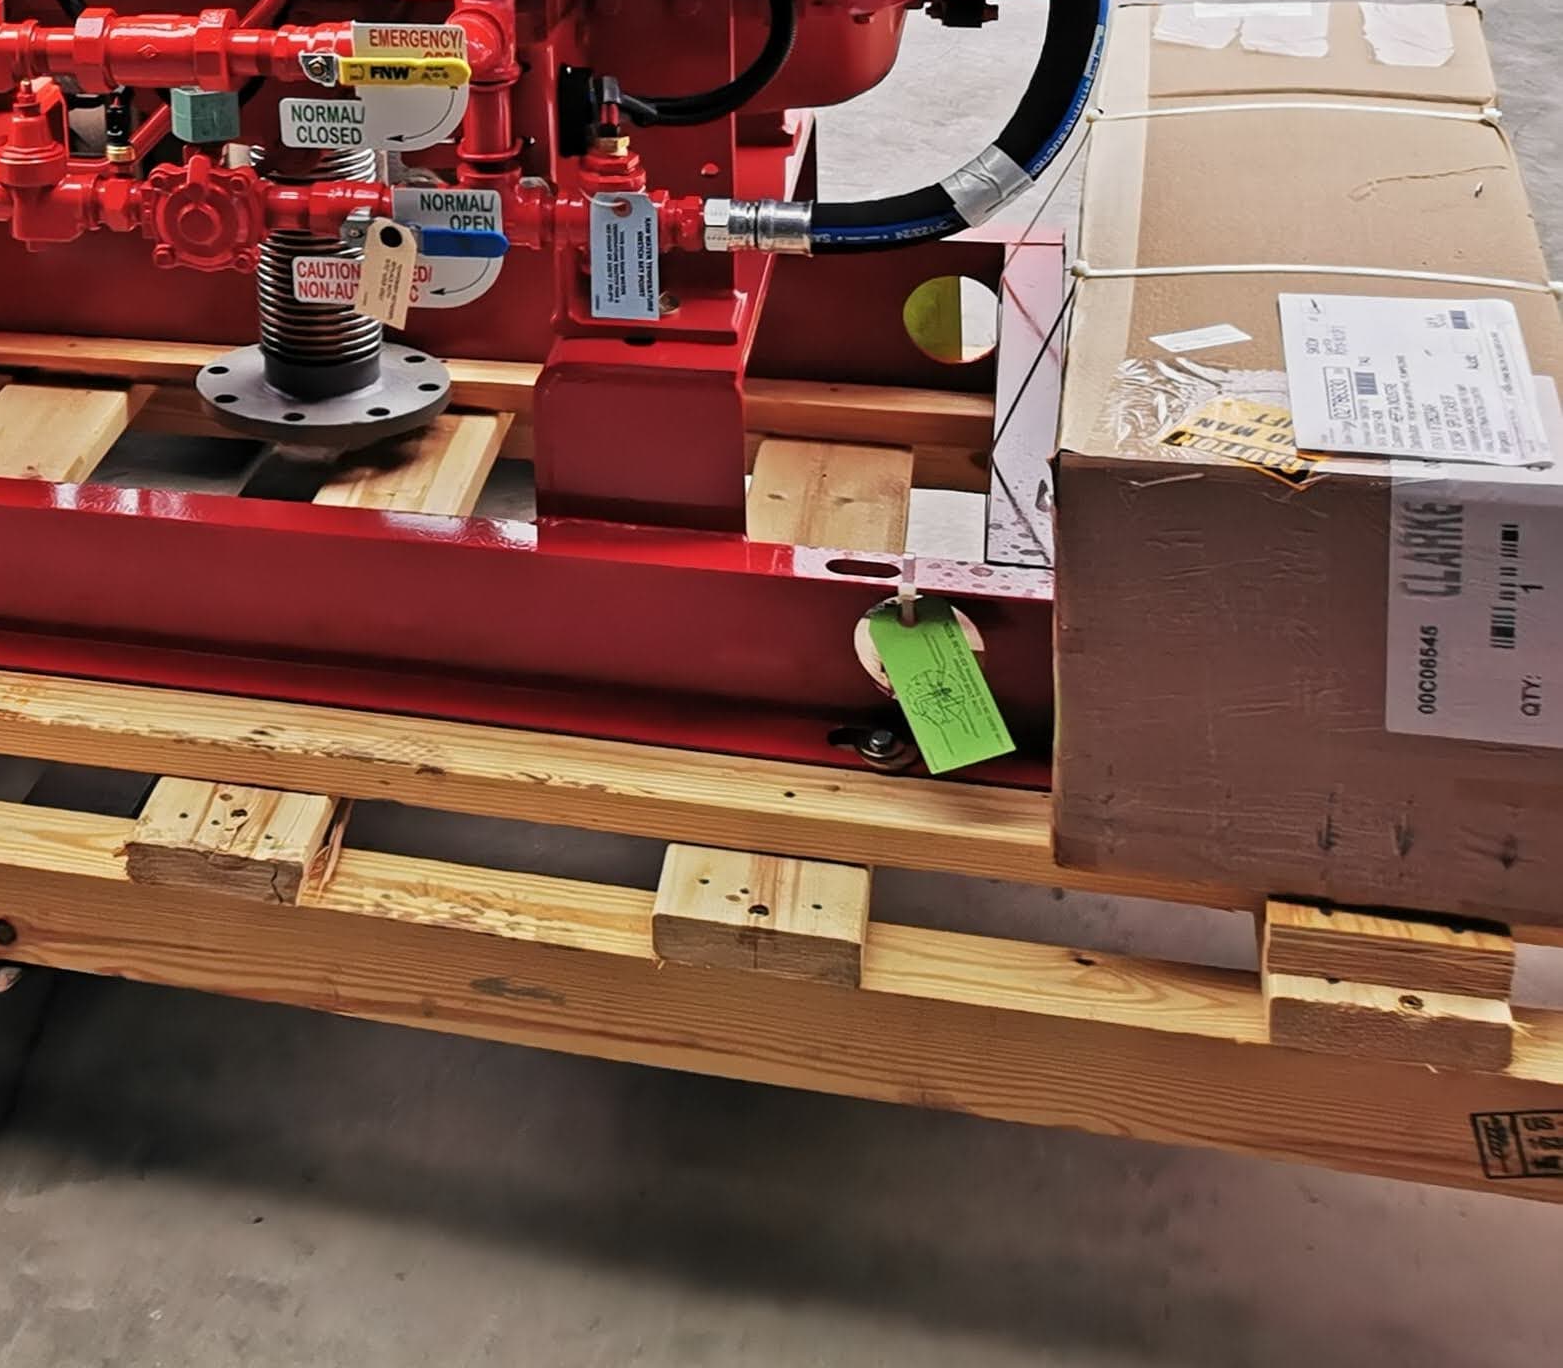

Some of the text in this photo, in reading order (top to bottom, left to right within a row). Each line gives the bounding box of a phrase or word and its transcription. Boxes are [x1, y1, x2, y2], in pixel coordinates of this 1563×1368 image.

[370, 65, 410, 80] FNW
[291, 104, 366, 125] NORMAL/
[296, 126, 363, 145] CLOSED
[420, 192, 495, 212] NORMAL/
[449, 214, 495, 232] OPEN
[296, 261, 361, 280] CAUTION
[1399, 502, 1464, 598] CLARKE
